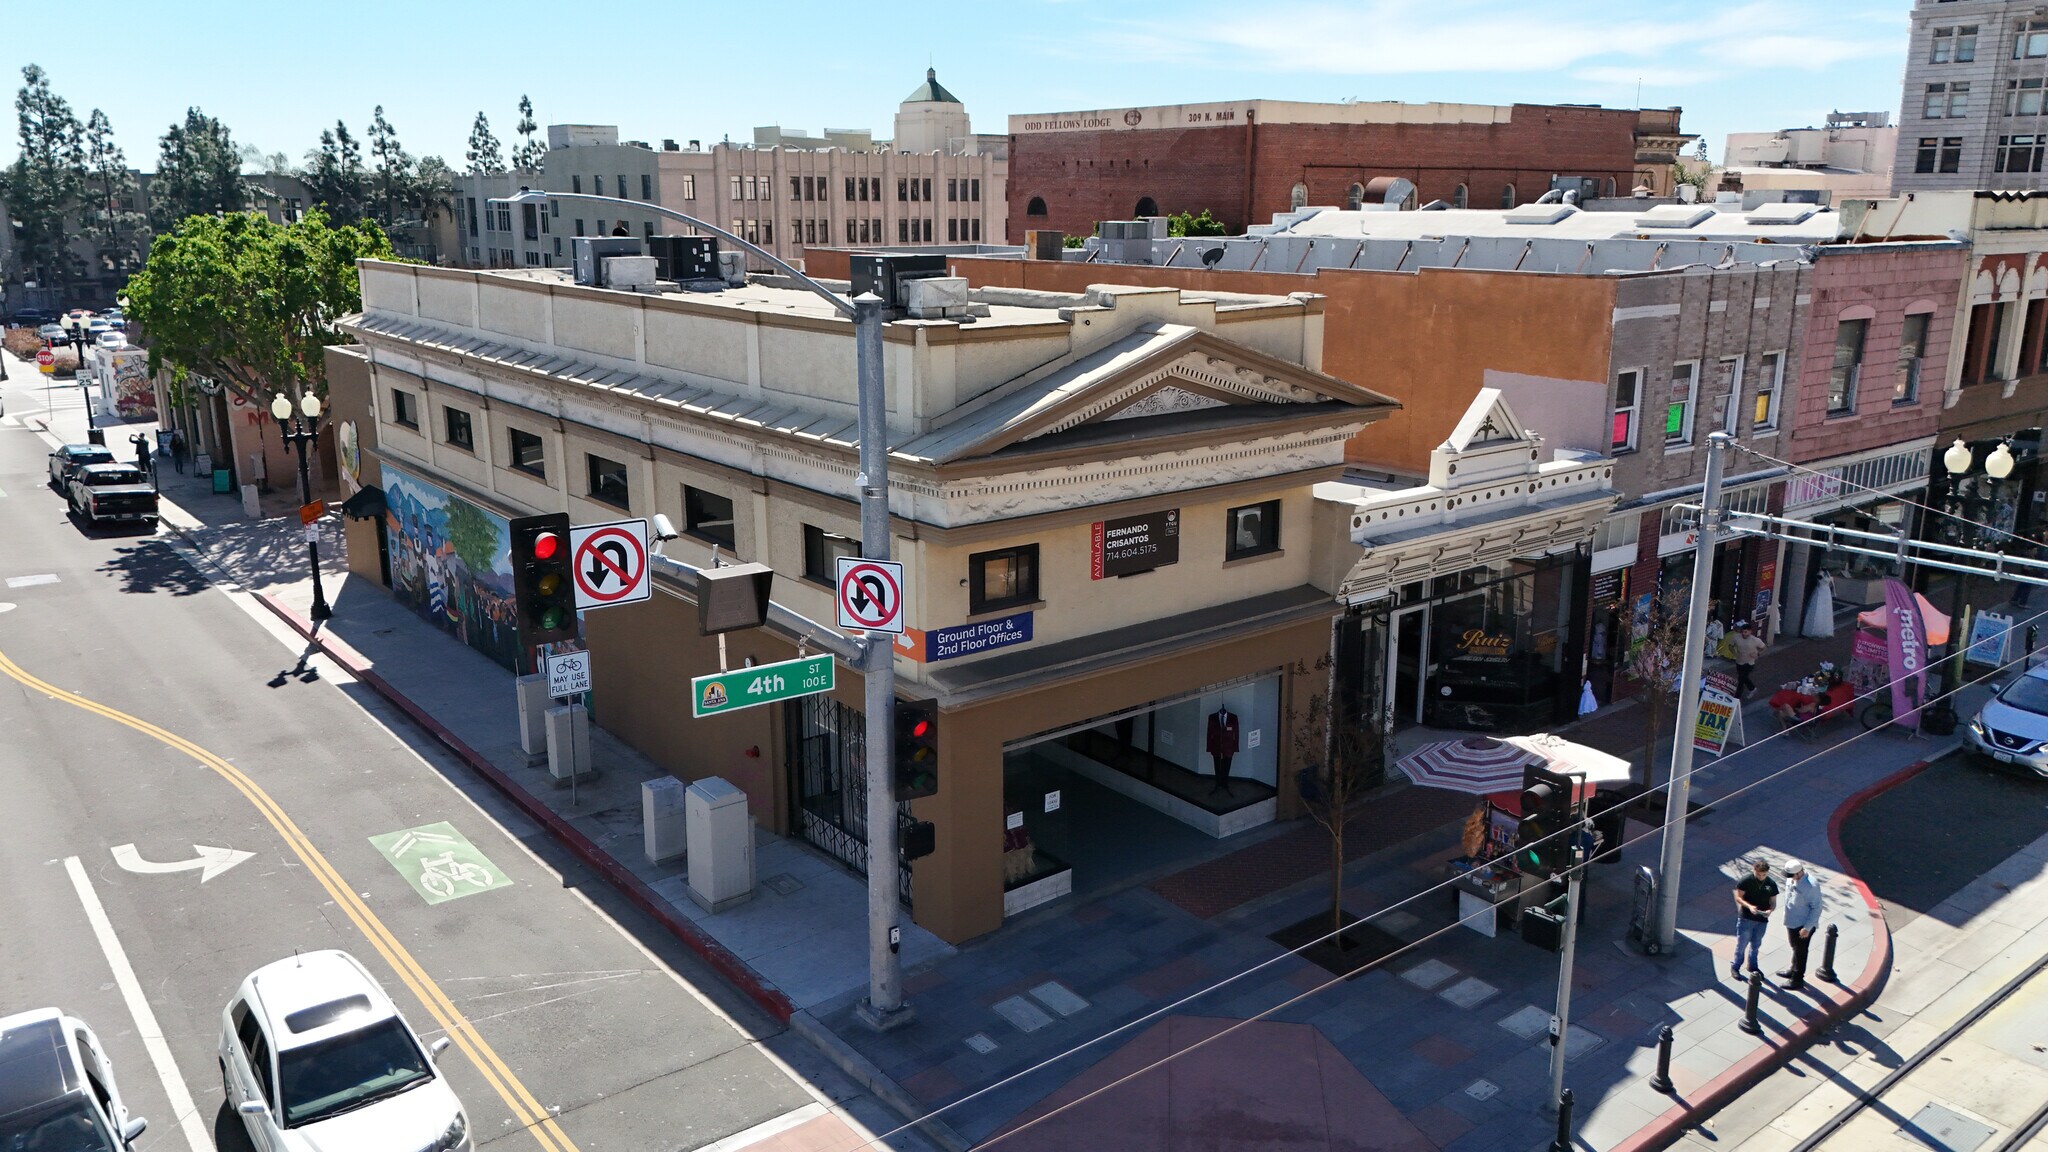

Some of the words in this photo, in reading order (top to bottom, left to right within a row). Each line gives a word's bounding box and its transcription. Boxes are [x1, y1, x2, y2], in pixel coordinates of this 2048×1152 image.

[1024, 122, 1042, 130] ODD
[1044, 119, 1080, 130] FELLOWS
[1083, 118, 1112, 128] LODGE
[1188, 113, 1202, 122] 309
[1216, 111, 1234, 120] MAIN
[1106, 524, 1149, 538] FERNANDO
[1106, 534, 1149, 549] CRISANTOS
[1094, 524, 1102, 577] AVAILABLE
[1106, 544, 1157, 561] 714.604.5175
[937, 626, 975, 644] Ground
[978, 622, 1004, 636] Floor
[1005, 619, 1014, 630] &
[1456, 629, 1513, 649] Ruiz
[1894, 606, 1920, 670] metro
[937, 642, 958, 656] 2nd
[960, 637, 986, 652] Floor
[989, 630, 1022, 646] Offices
[808, 663, 820, 674] ST
[552, 685, 568, 693] FULL
[571, 680, 588, 690] LANE
[554, 675, 568, 684] MAY
[572, 672, 586, 680] USE
[747, 674, 785, 695] 4th
[1701, 700, 1732, 717] INCOME
[1699, 711, 1729, 731] TAX
